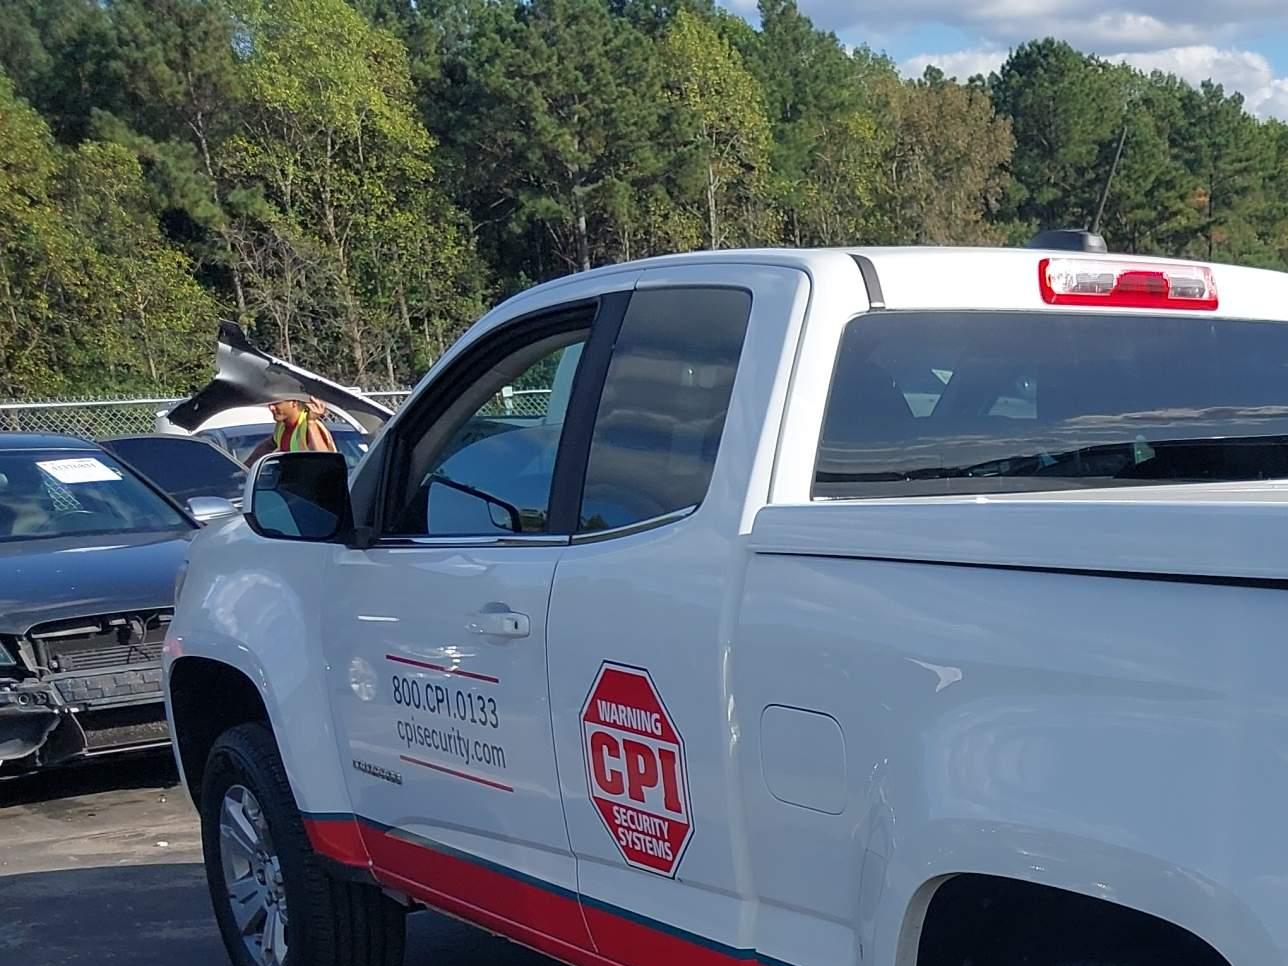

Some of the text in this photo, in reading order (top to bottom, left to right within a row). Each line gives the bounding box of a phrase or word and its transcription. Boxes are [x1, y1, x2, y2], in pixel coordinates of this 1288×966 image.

[392, 675, 499, 729] 800.CPI.0133
[596, 699, 662, 736] WARNING
[396, 716, 507, 769] cpisecurity.com
[590, 731, 683, 814] CPI
[612, 805, 669, 839] SECURITY
[617, 826, 673, 861] SYSTEMS
